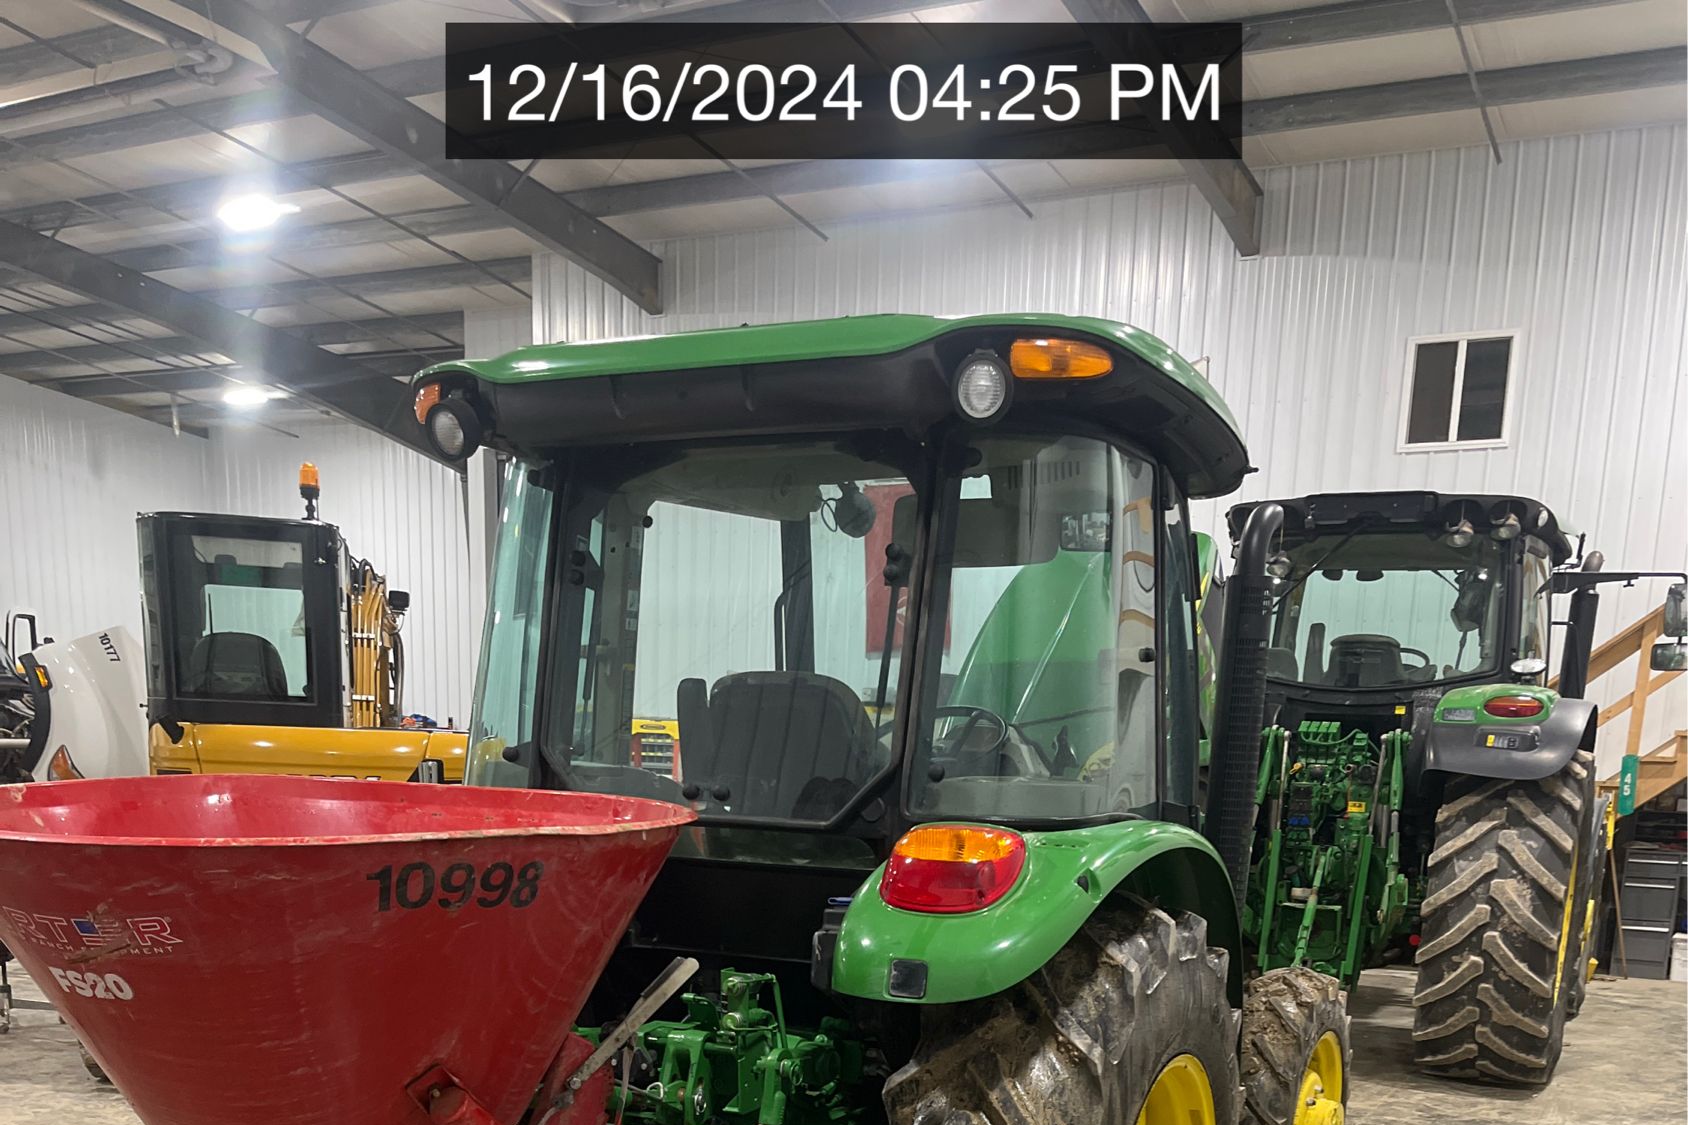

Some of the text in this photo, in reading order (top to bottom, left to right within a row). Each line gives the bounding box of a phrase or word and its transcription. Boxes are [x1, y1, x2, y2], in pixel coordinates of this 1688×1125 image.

[99, 633, 121, 662] 10177
[366, 860, 545, 913] 10998
[48, 966, 134, 1001] FS20
